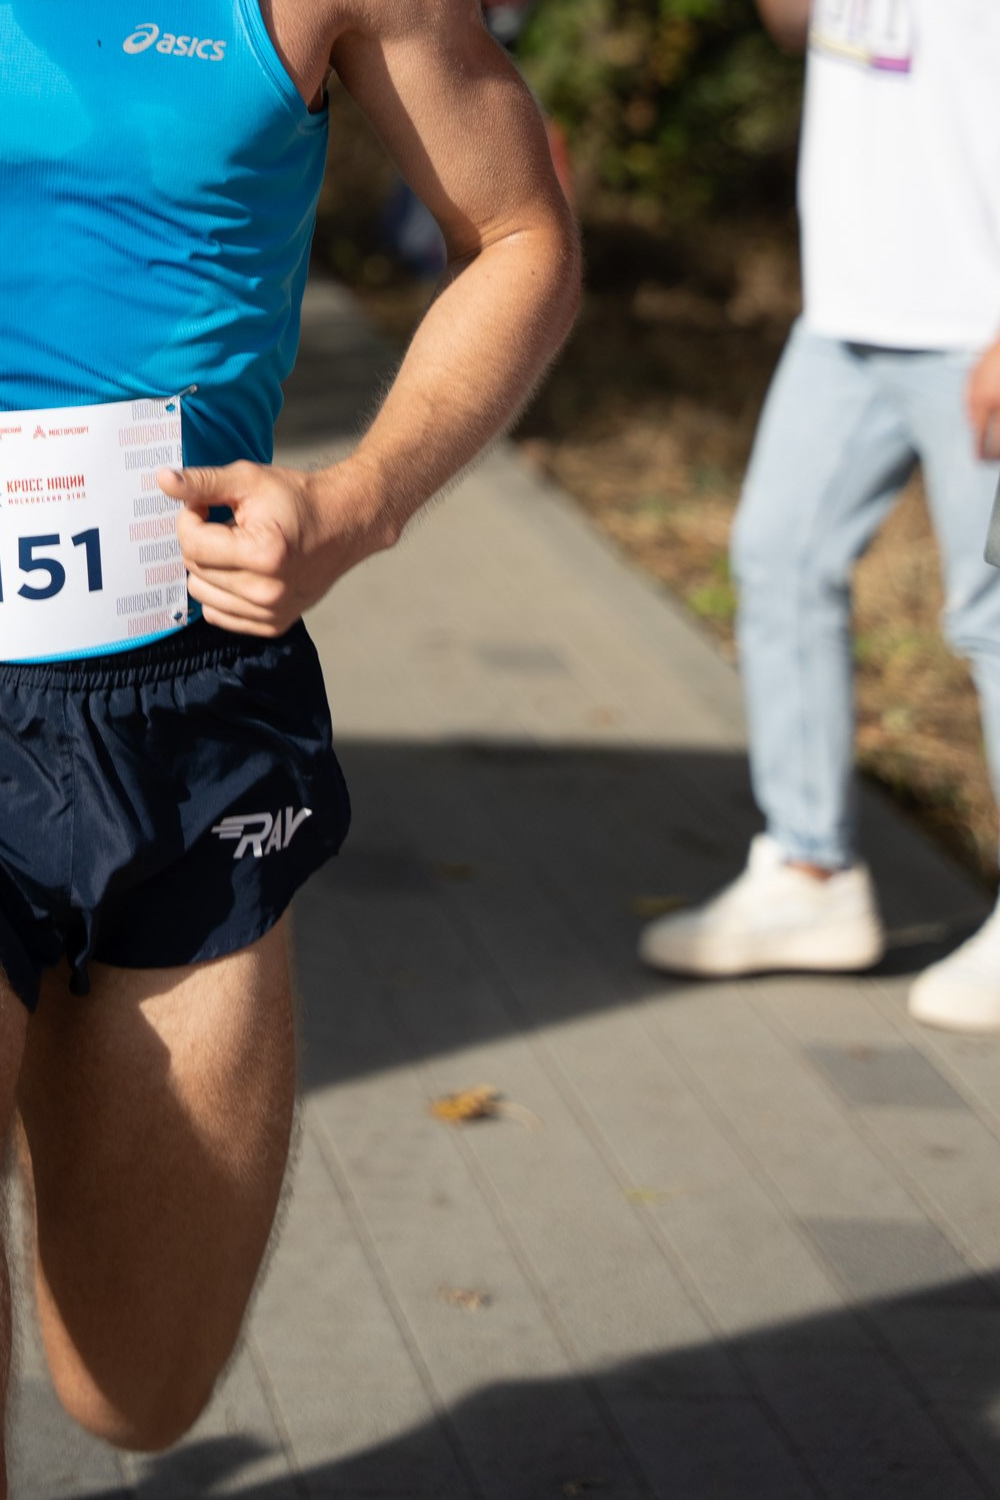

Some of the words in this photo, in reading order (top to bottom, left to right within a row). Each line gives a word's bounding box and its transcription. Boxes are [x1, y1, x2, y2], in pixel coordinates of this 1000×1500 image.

[6, 478, 43, 493] КРОСС
[47, 473, 85, 491] НАЦИИ
[211, 806, 313, 860] RAY
